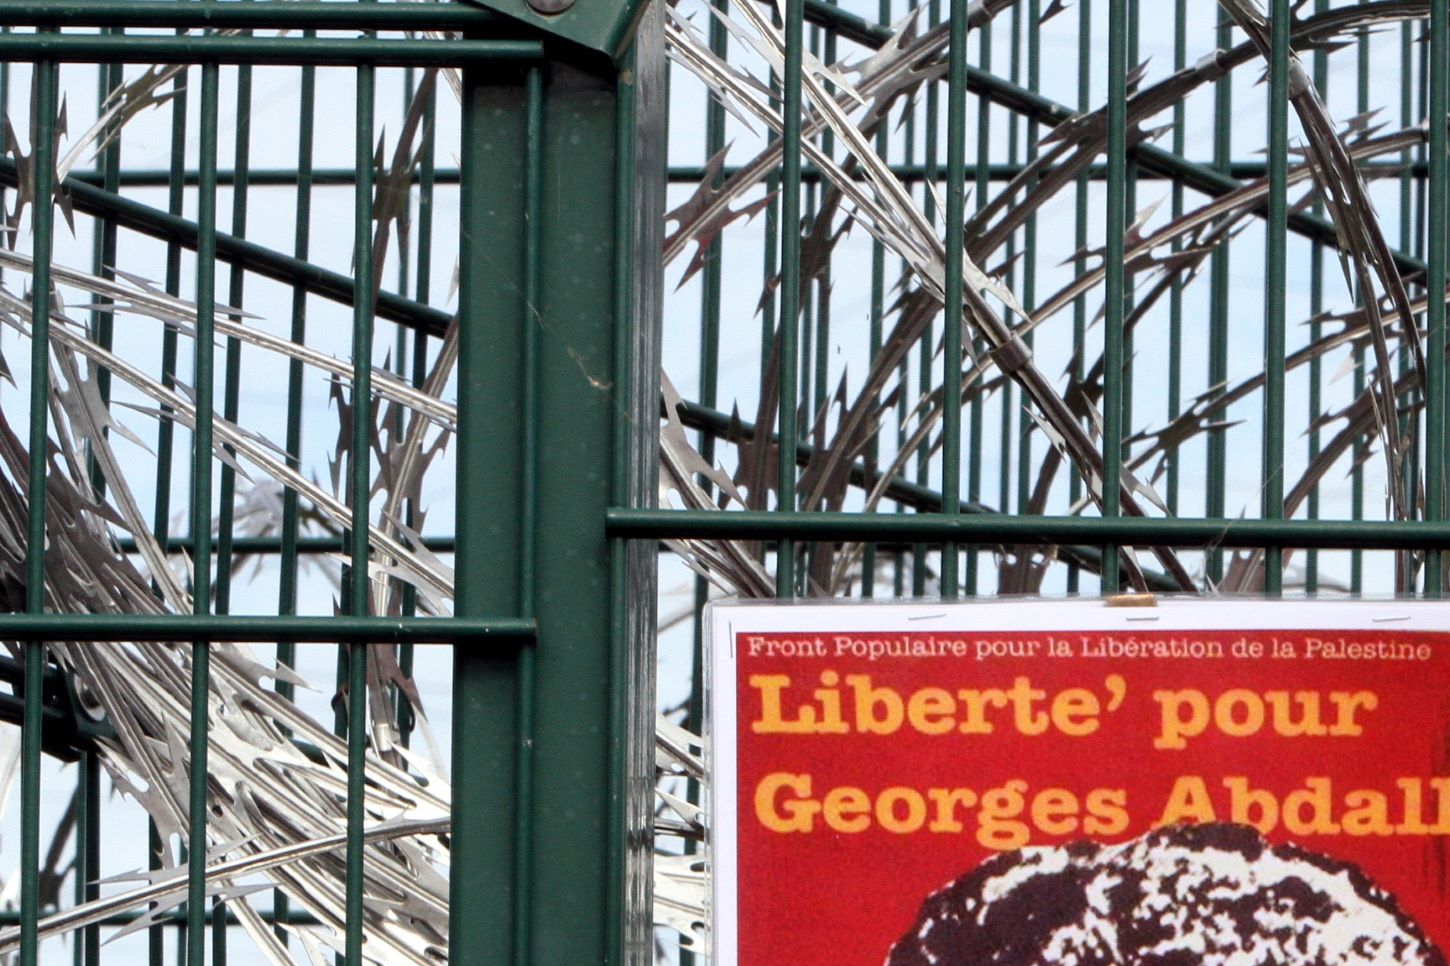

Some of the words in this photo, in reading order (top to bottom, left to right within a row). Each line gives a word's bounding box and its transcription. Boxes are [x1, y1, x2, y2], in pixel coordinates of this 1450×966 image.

[747, 636, 828, 657] Front
[833, 636, 968, 662] Populaire
[974, 639, 1041, 662] pour
[1047, 636, 1074, 658] la
[1080, 636, 1224, 659] Libération
[1231, 637, 1264, 659] de
[1271, 638, 1297, 659] la
[1305, 638, 1432, 661] Palestine
[1152, 688, 1378, 750] pour
[754, 771, 1130, 852] Georges
